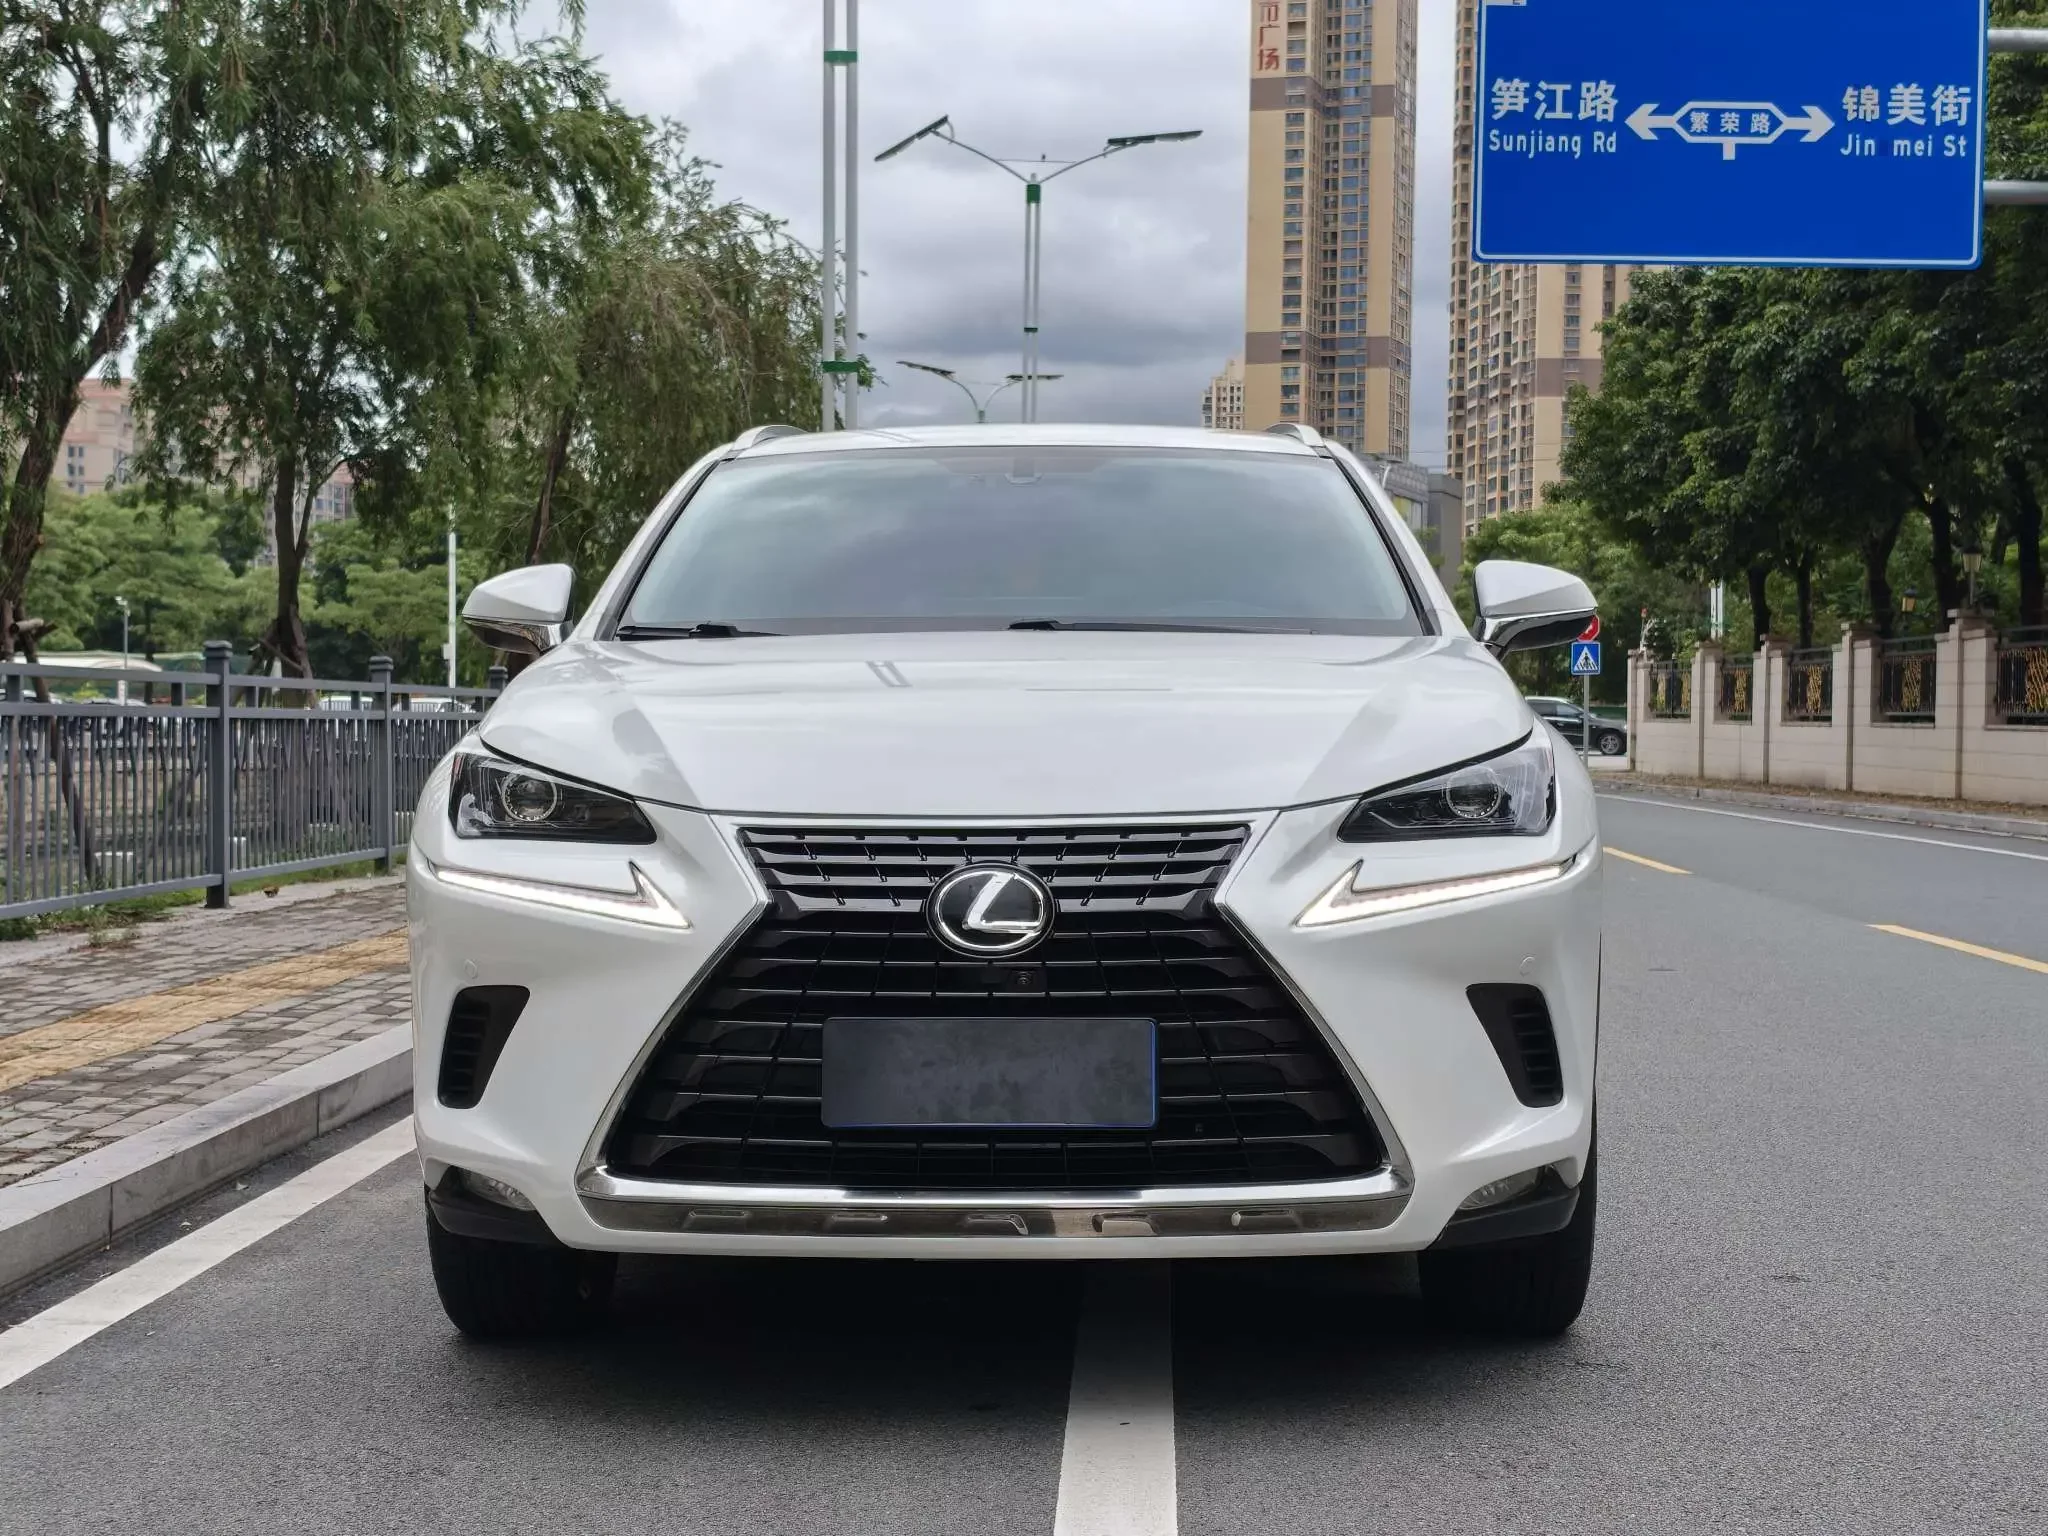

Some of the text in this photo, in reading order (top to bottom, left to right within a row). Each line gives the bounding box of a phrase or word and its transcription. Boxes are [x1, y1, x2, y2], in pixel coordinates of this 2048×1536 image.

[1491, 78, 1618, 122] 笋江路
[1842, 83, 1972, 126] 锦美街
[1689, 110, 1771, 135] 繁荣路
[1489, 129, 1617, 159] Sunjiang Rd
[1840, 134, 1967, 157] Jin mei St
